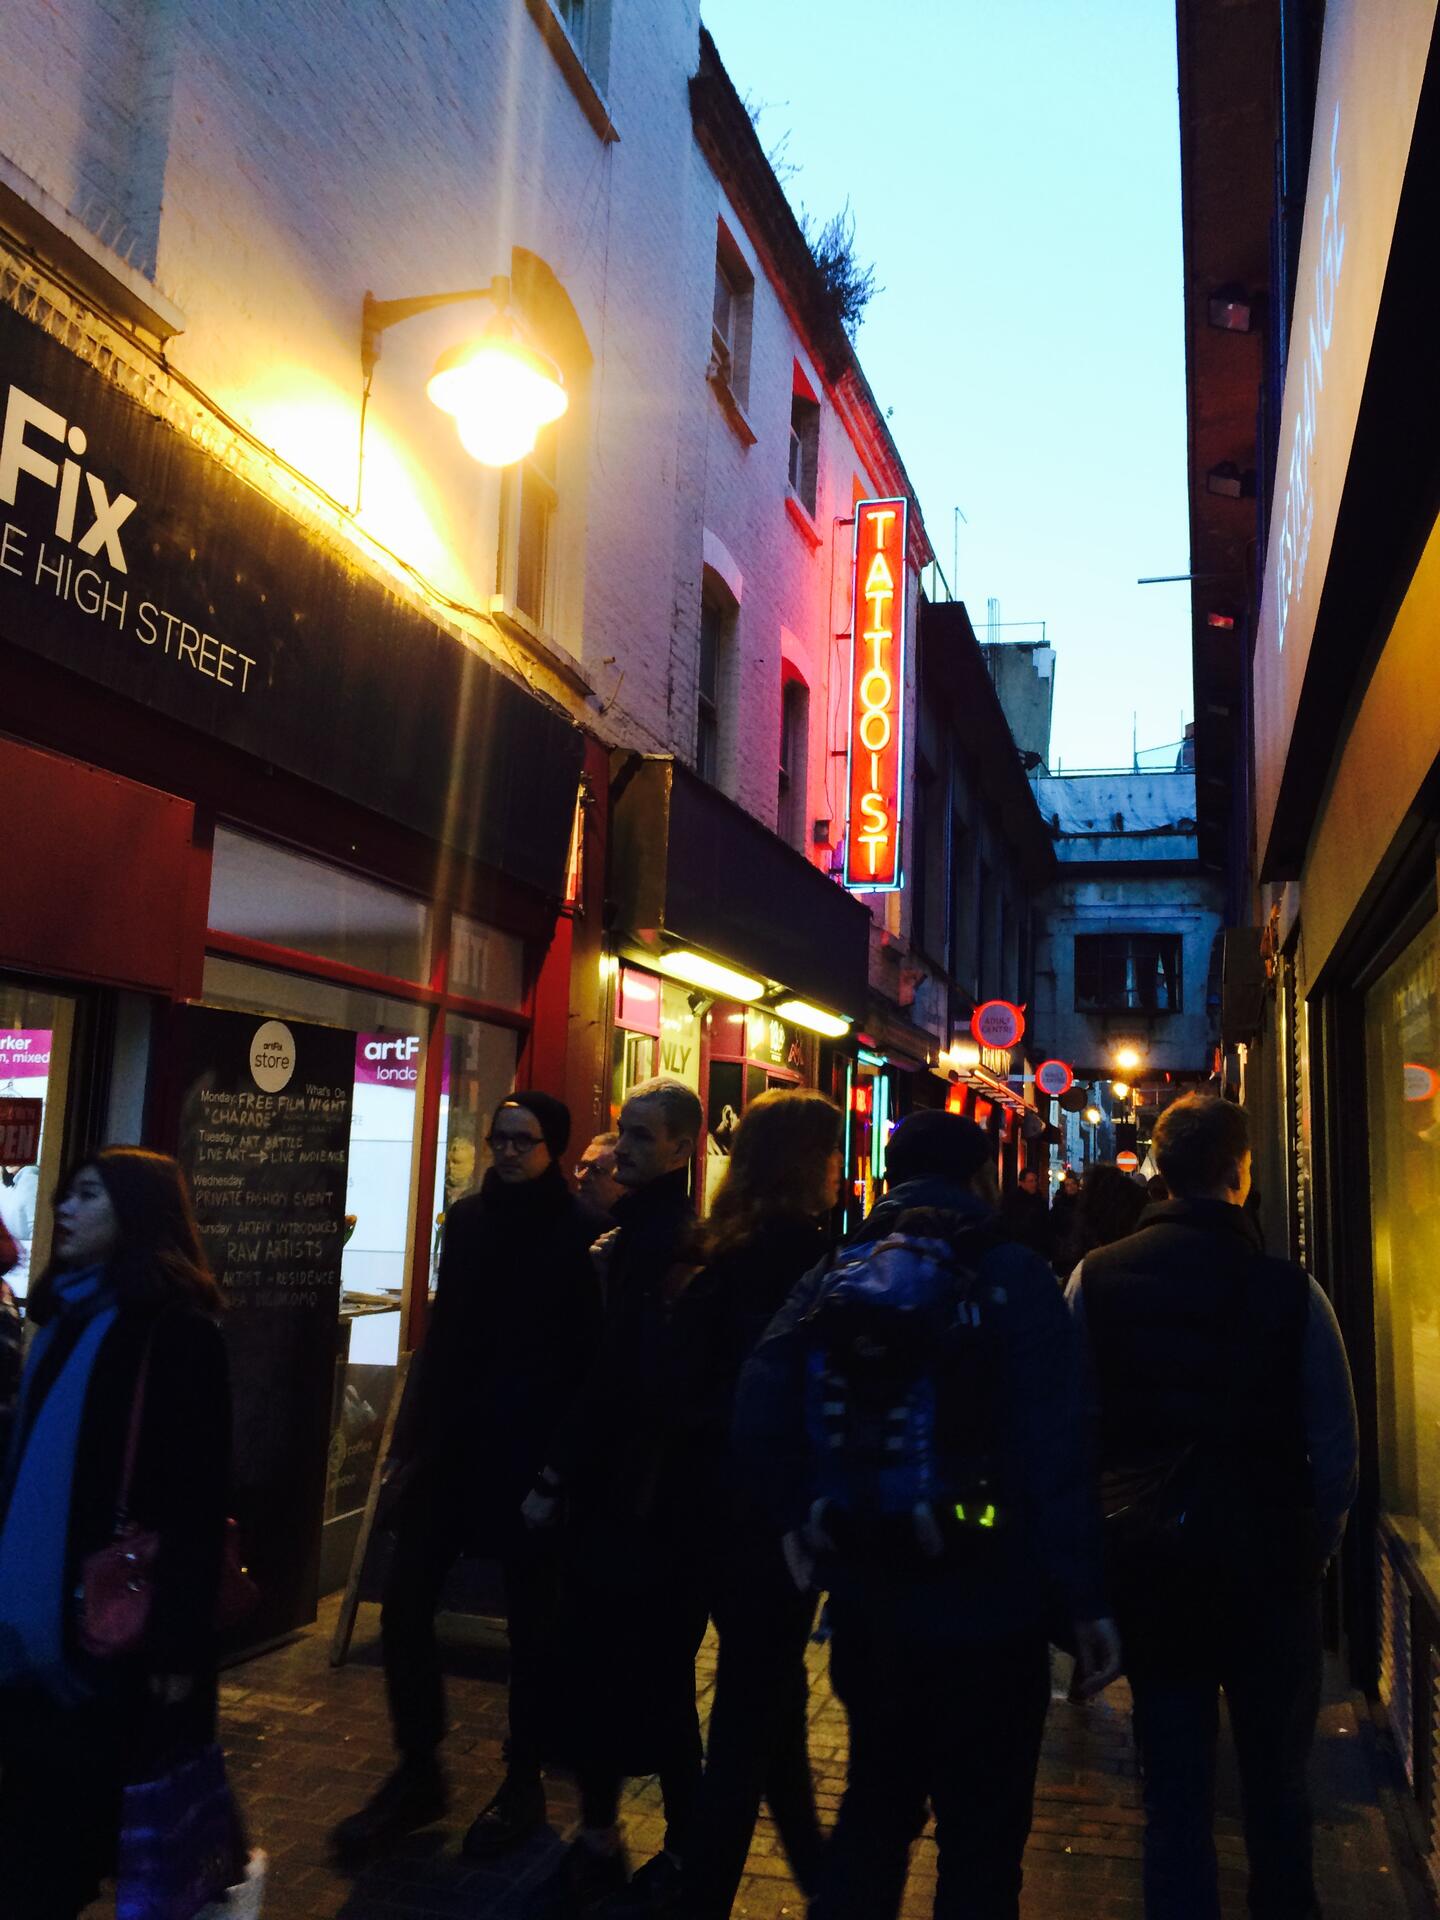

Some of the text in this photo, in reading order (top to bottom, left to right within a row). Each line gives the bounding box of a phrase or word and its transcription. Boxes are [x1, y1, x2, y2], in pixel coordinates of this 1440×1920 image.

[0, 384, 138, 575] Fix
[34, 542, 128, 631] HIGH
[135, 601, 257, 693] STREET
[857, 510, 897, 877] TATTOOIST
[12, 1051, 51, 1064] mixed
[254, 1052, 290, 1070] store
[238, 1092, 274, 1110] FREE
[278, 1095, 305, 1112] FILM
[309, 1097, 347, 1113] NIGHT
[334, 1087, 346, 1099] On
[240, 1135, 260, 1149] ART
[265, 1135, 303, 1151] BATTLE
[199, 1147, 223, 1161] LIVE
[225, 1148, 248, 1161] ART
[271, 1150, 295, 1163] LIVE
[195, 1189, 241, 1208] PRIVATE
[294, 1191, 334, 1207] EVENT
[227, 1239, 323, 1262] RAW ARTISTS
